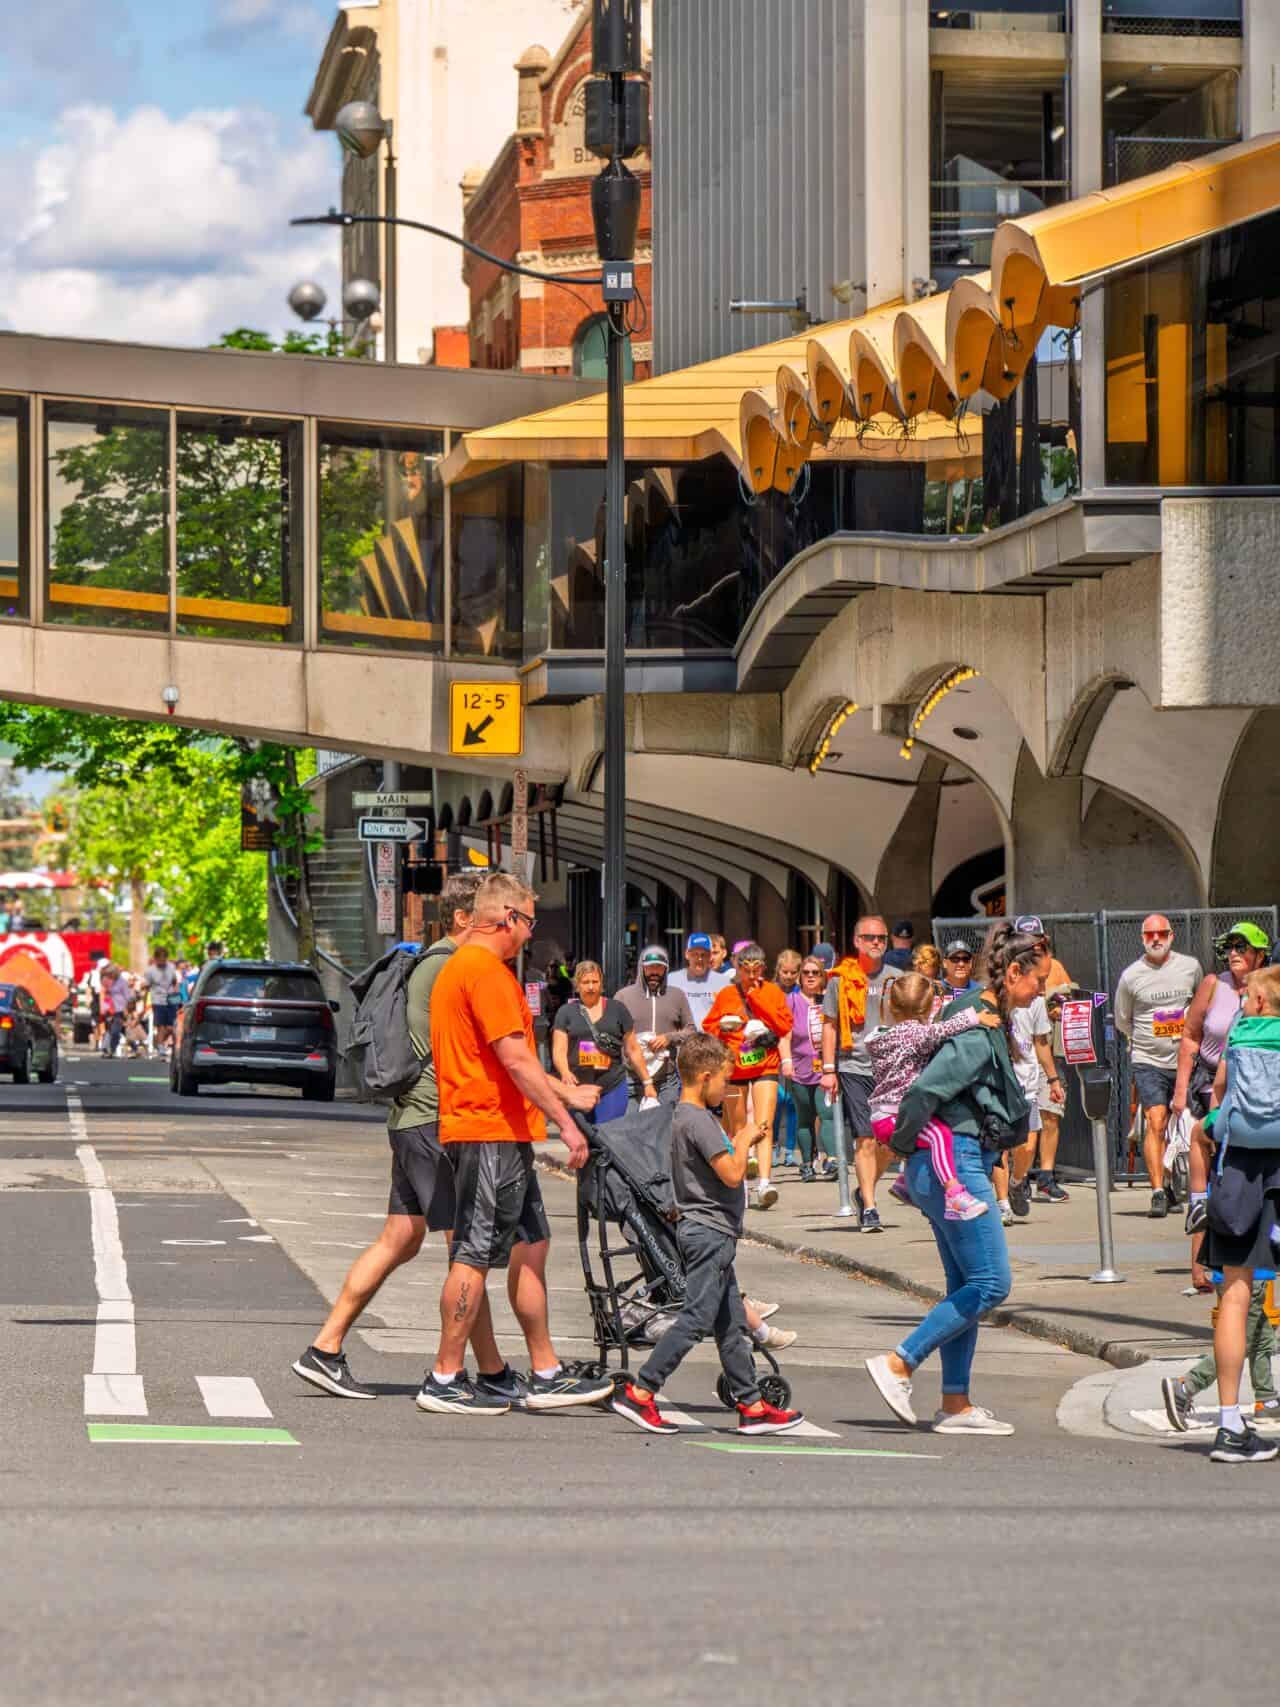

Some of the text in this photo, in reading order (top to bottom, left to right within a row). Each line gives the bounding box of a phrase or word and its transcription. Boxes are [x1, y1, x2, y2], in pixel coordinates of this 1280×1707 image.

[463, 693, 505, 710] 12-5
[376, 793, 409, 804] MAIN
[366, 823, 407, 833] ONE WAY
